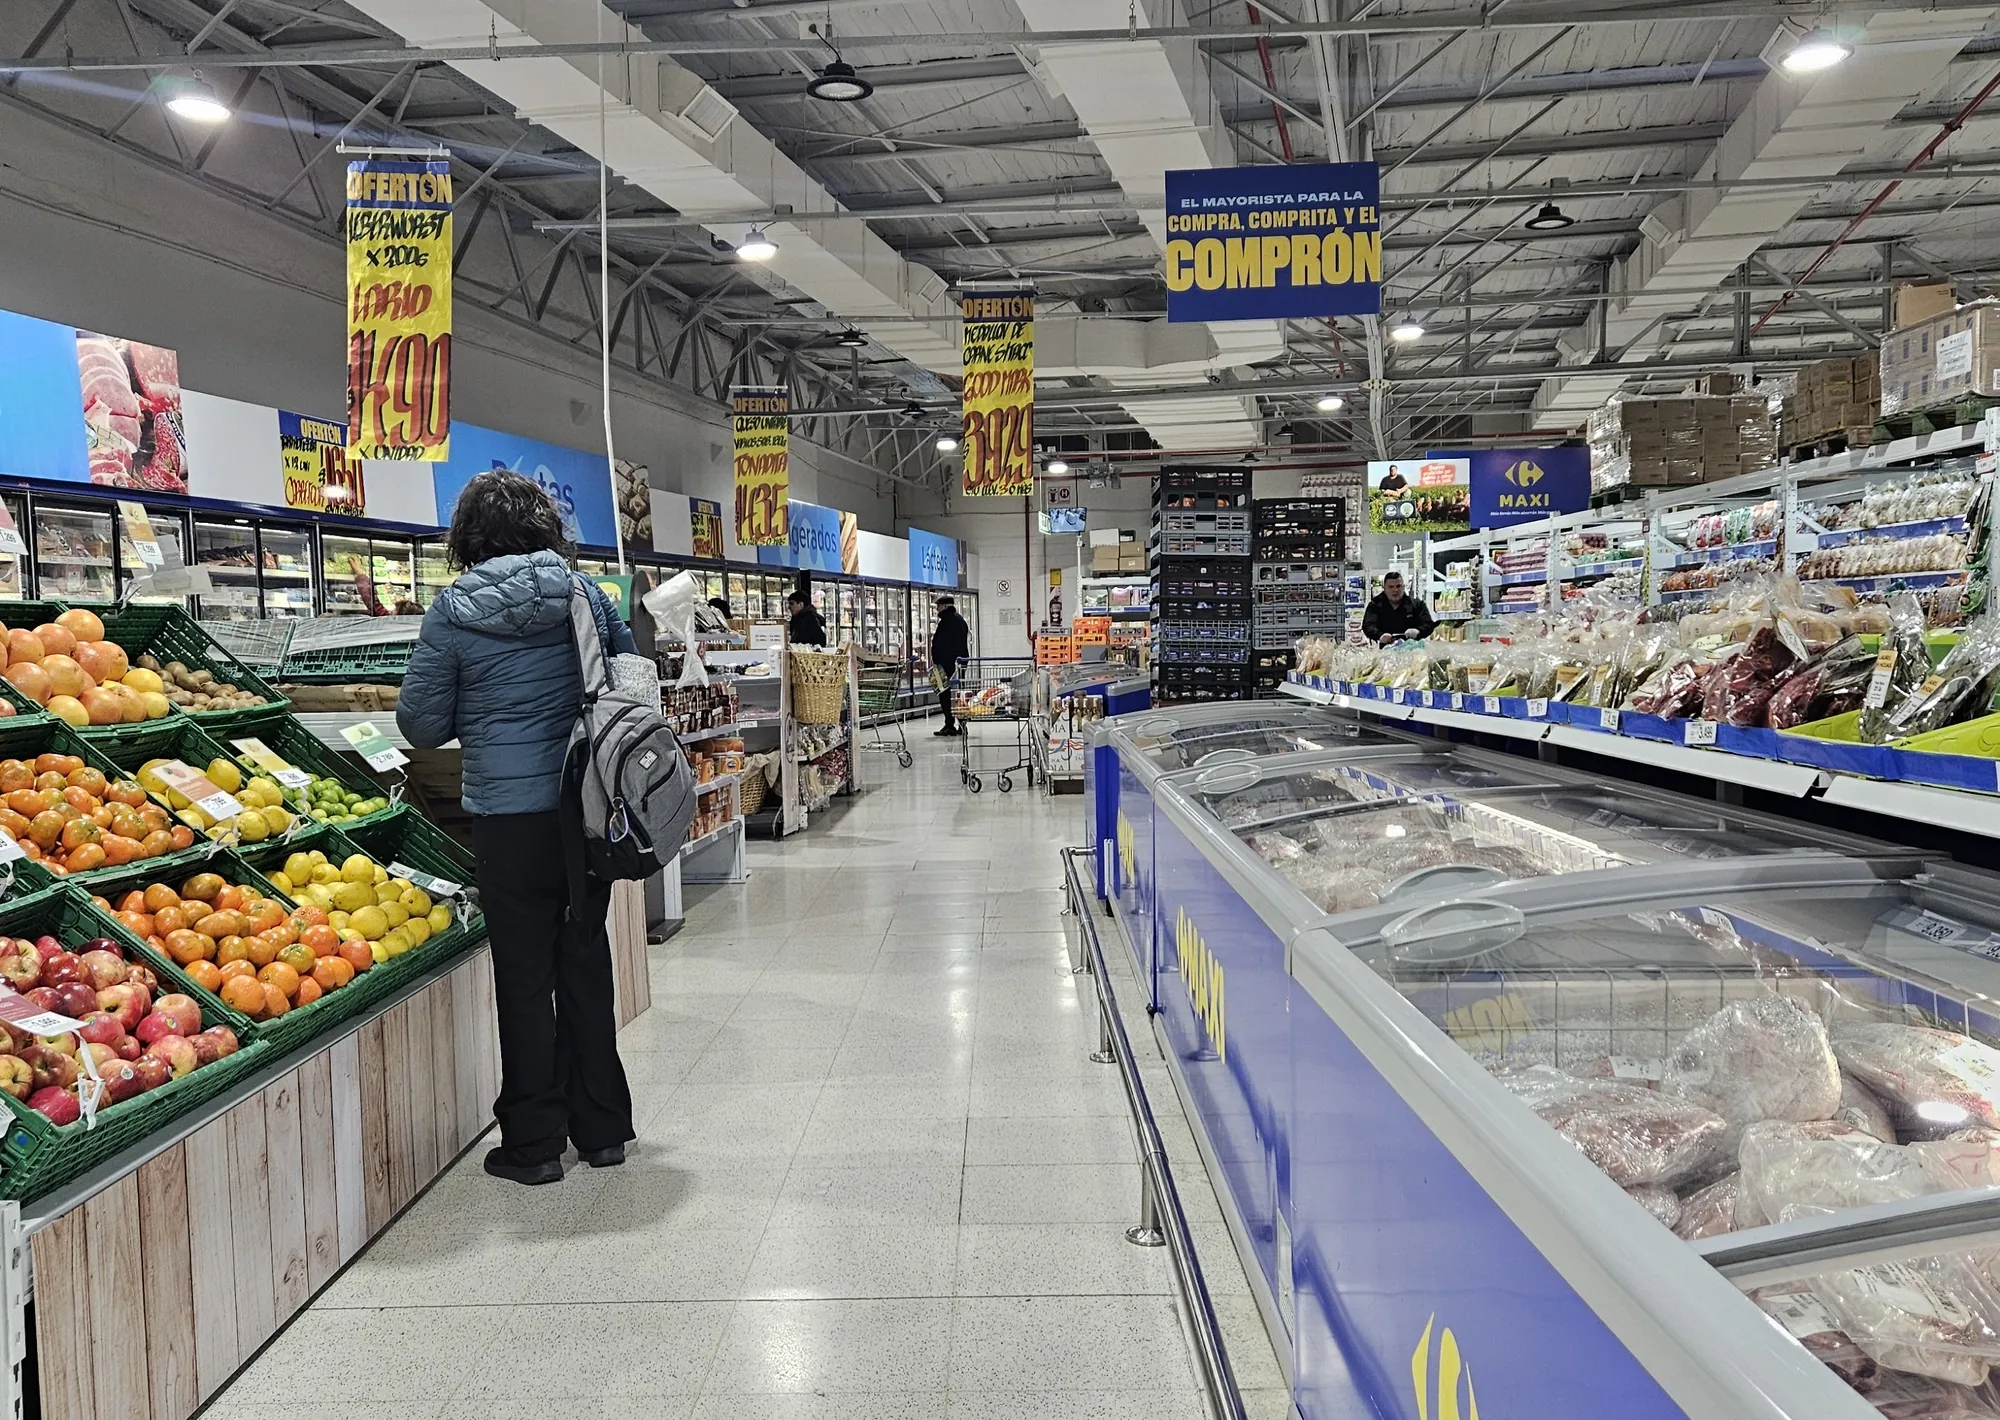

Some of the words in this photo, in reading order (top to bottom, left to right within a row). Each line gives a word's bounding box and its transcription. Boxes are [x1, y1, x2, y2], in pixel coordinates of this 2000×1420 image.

[1181, 198, 1199, 208] EL
[1203, 194, 1294, 207] MAYORISTA
[1298, 192, 1339, 203] PARA
[1343, 190, 1364, 201] LA
[1168, 213, 1245, 232] COMPRA,
[1249, 208, 1337, 228] COMPRITA
[1343, 207, 1355, 224] Y
[1359, 206, 1378, 224] EL
[1167, 227, 1381, 292] COMPRÓN
[1499, 494, 1550, 507] MAXI
[921, 545, 948, 573] Lácteos
